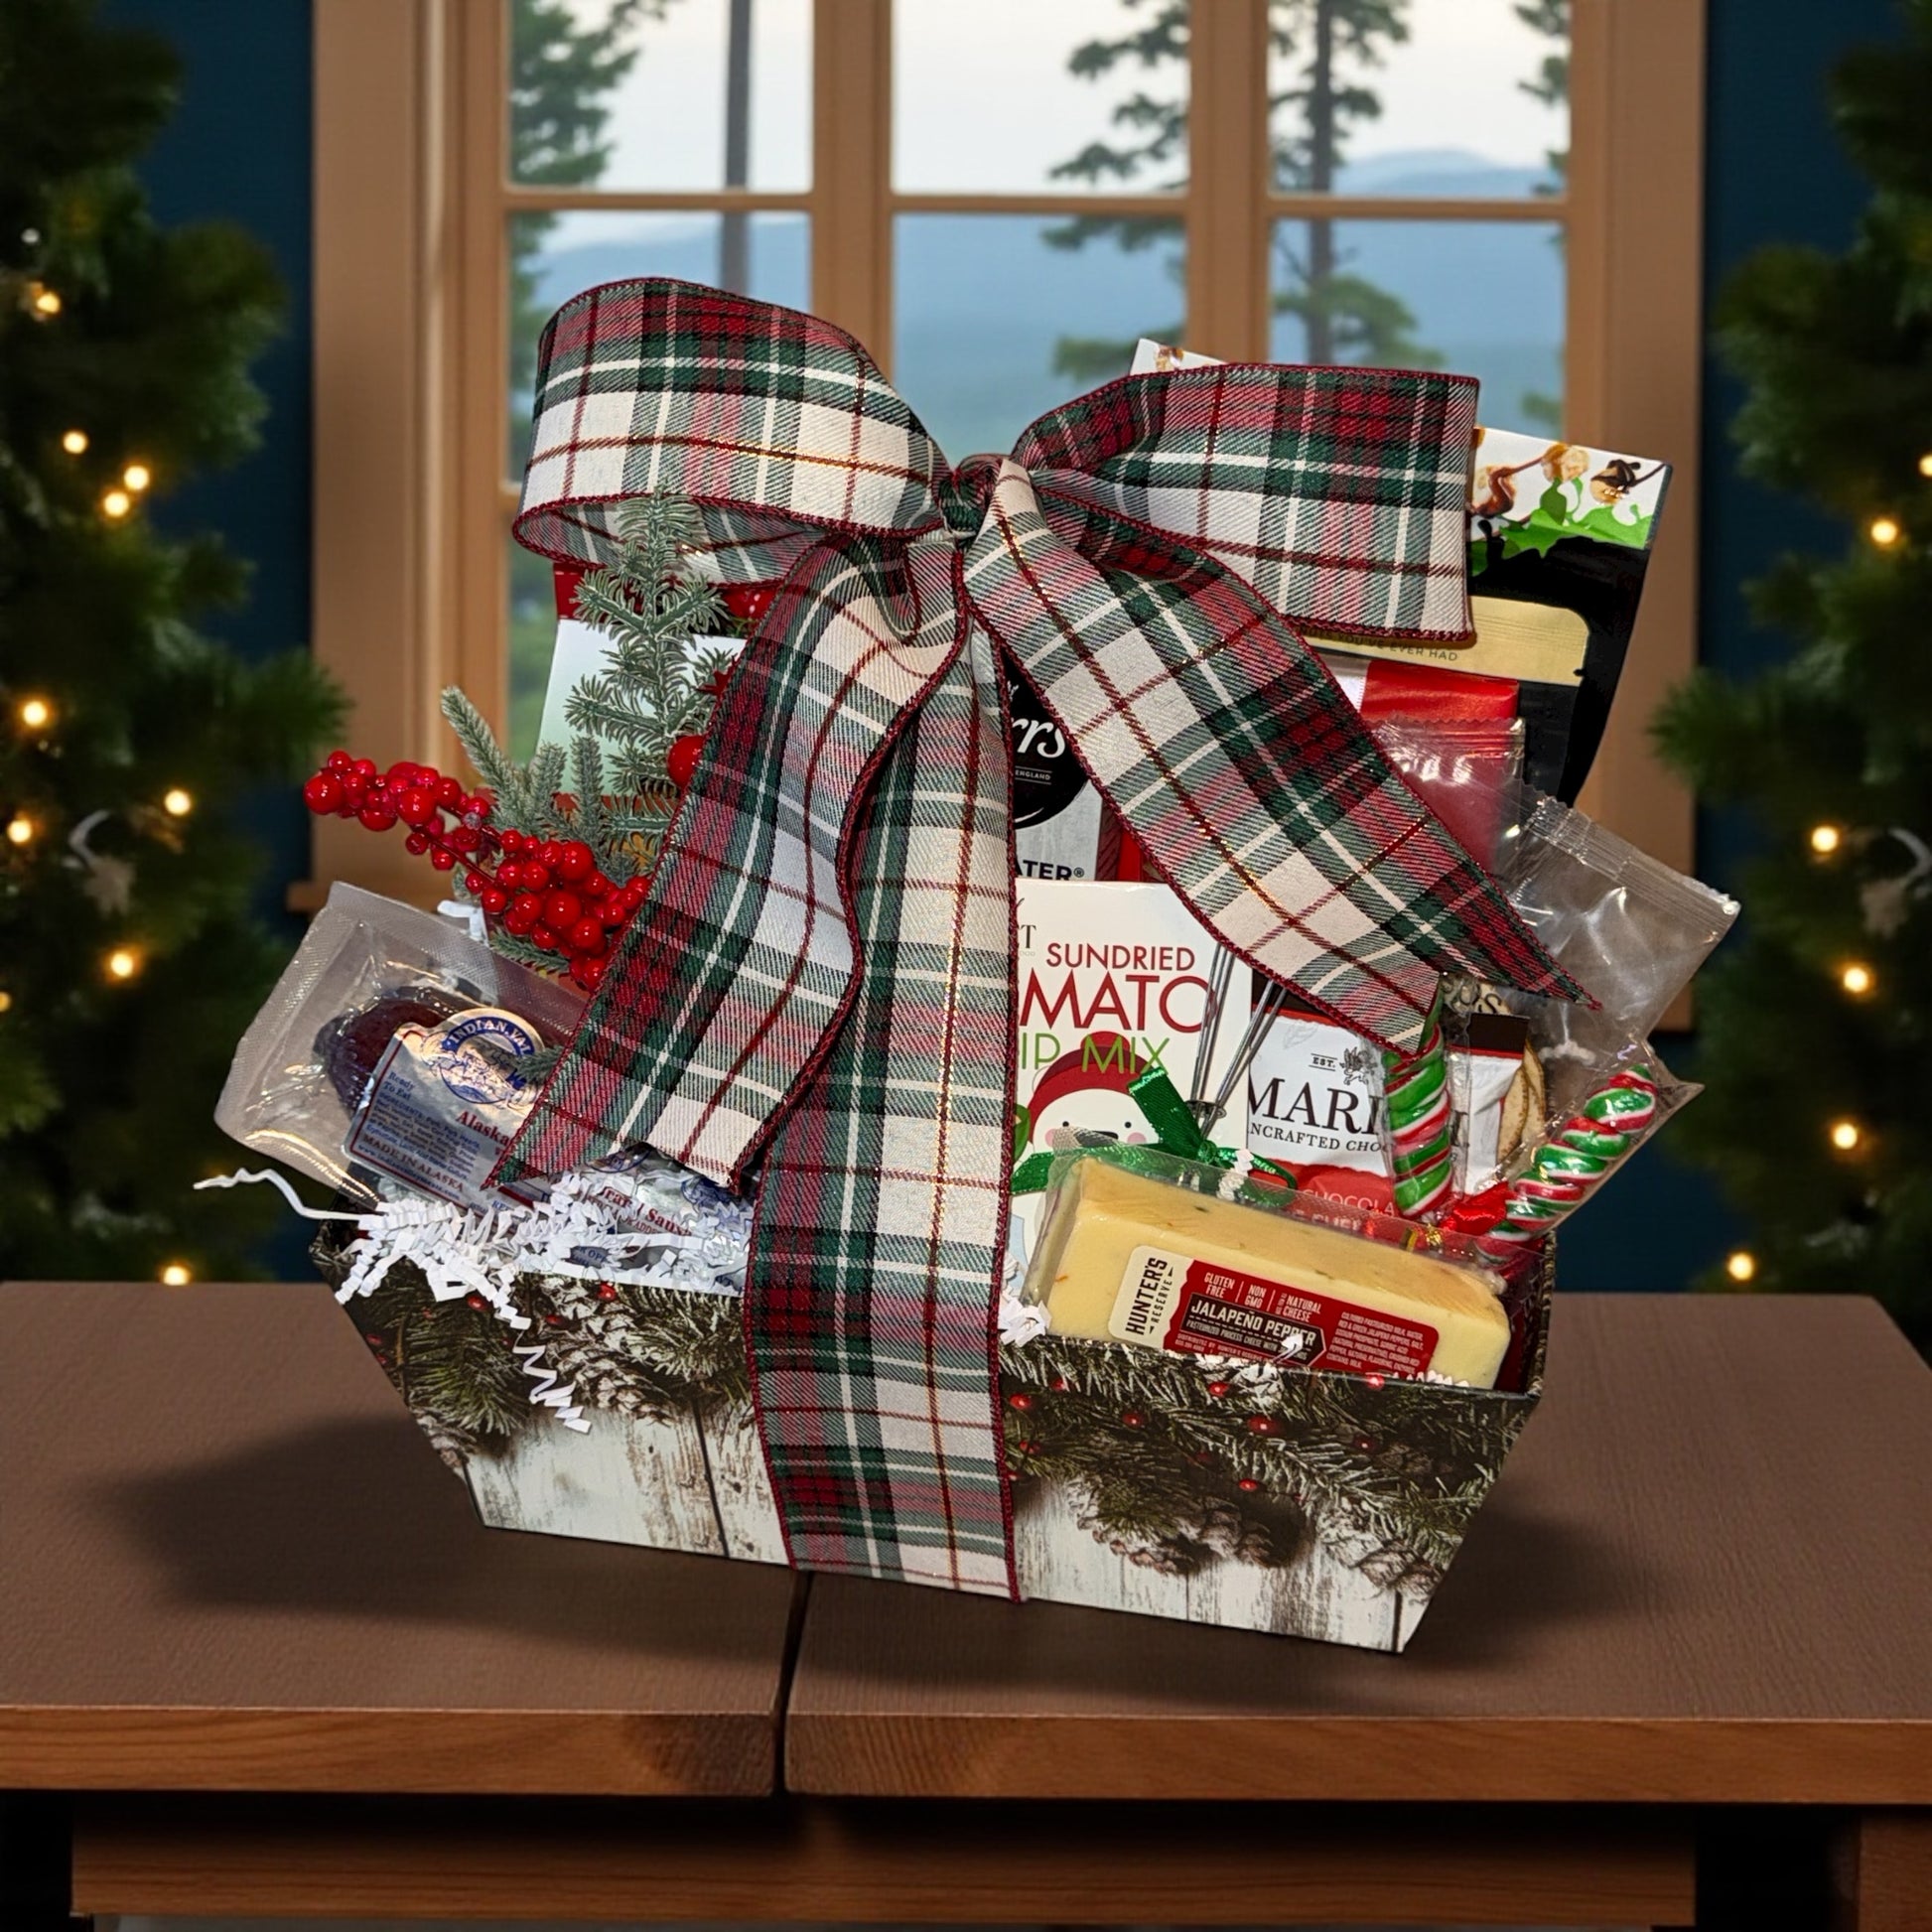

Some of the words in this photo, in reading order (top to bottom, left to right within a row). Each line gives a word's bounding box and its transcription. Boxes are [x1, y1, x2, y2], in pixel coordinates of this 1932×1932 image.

[1391, 642, 1425, 656] EVER
[1429, 649, 1458, 661] HAD
[1015, 769, 1051, 780] ENGLAND
[1045, 942, 1195, 972] SUNDRIED
[1019, 967, 1218, 1034] MATO
[448, 1020, 504, 1043] INDIAN
[1021, 1032, 1061, 1070] IP
[1081, 1034, 1170, 1075] MIX
[1311, 1056, 1336, 1068] EST.
[388, 1071, 415, 1090] Ready
[382, 1081, 395, 1092] To
[397, 1090, 411, 1101] Eat
[1248, 1073, 1380, 1136] MARI
[1247, 1123, 1340, 1150] NCRAFTED
[362, 1134, 398, 1157] MADE
[401, 1154, 418, 1168] IN
[417, 1162, 465, 1191] ALASKA
[1203, 1272, 1235, 1290] GLUTEN
[1125, 1257, 1169, 1335] HUNTER'S
[1152, 1279, 1173, 1323] RESERVE
[1205, 1284, 1227, 1299] FREE
[1248, 1284, 1267, 1299] NON
[1244, 1295, 1264, 1310] GMO
[1286, 1295, 1321, 1314] NATURAL
[1191, 1300, 1263, 1330] JALAPEÑO
[1282, 1306, 1312, 1322] CHEESE
